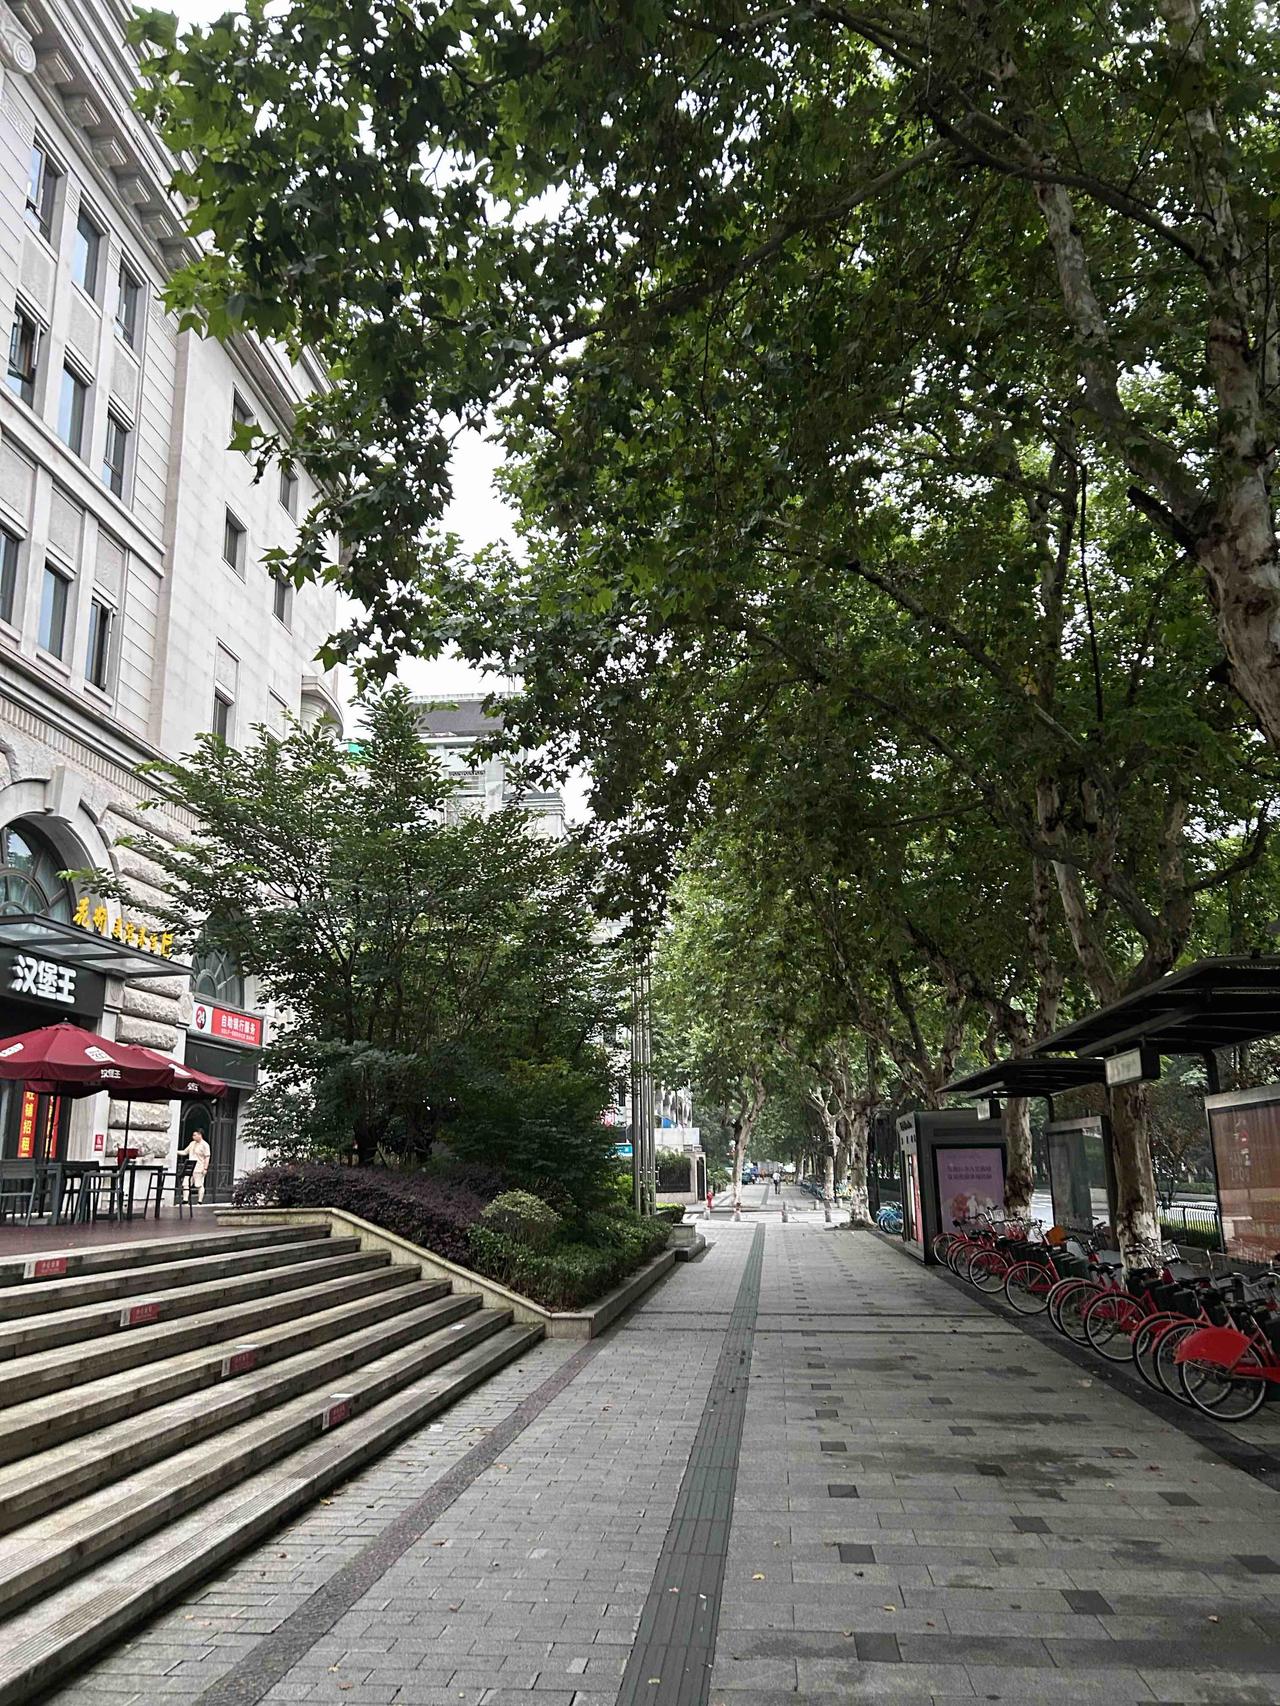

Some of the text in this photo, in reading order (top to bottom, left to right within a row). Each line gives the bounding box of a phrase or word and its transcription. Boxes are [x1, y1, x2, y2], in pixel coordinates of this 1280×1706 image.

[11, 955, 76, 1003] 汉堡王
[221, 1014, 255, 1035] 自助银行服务
